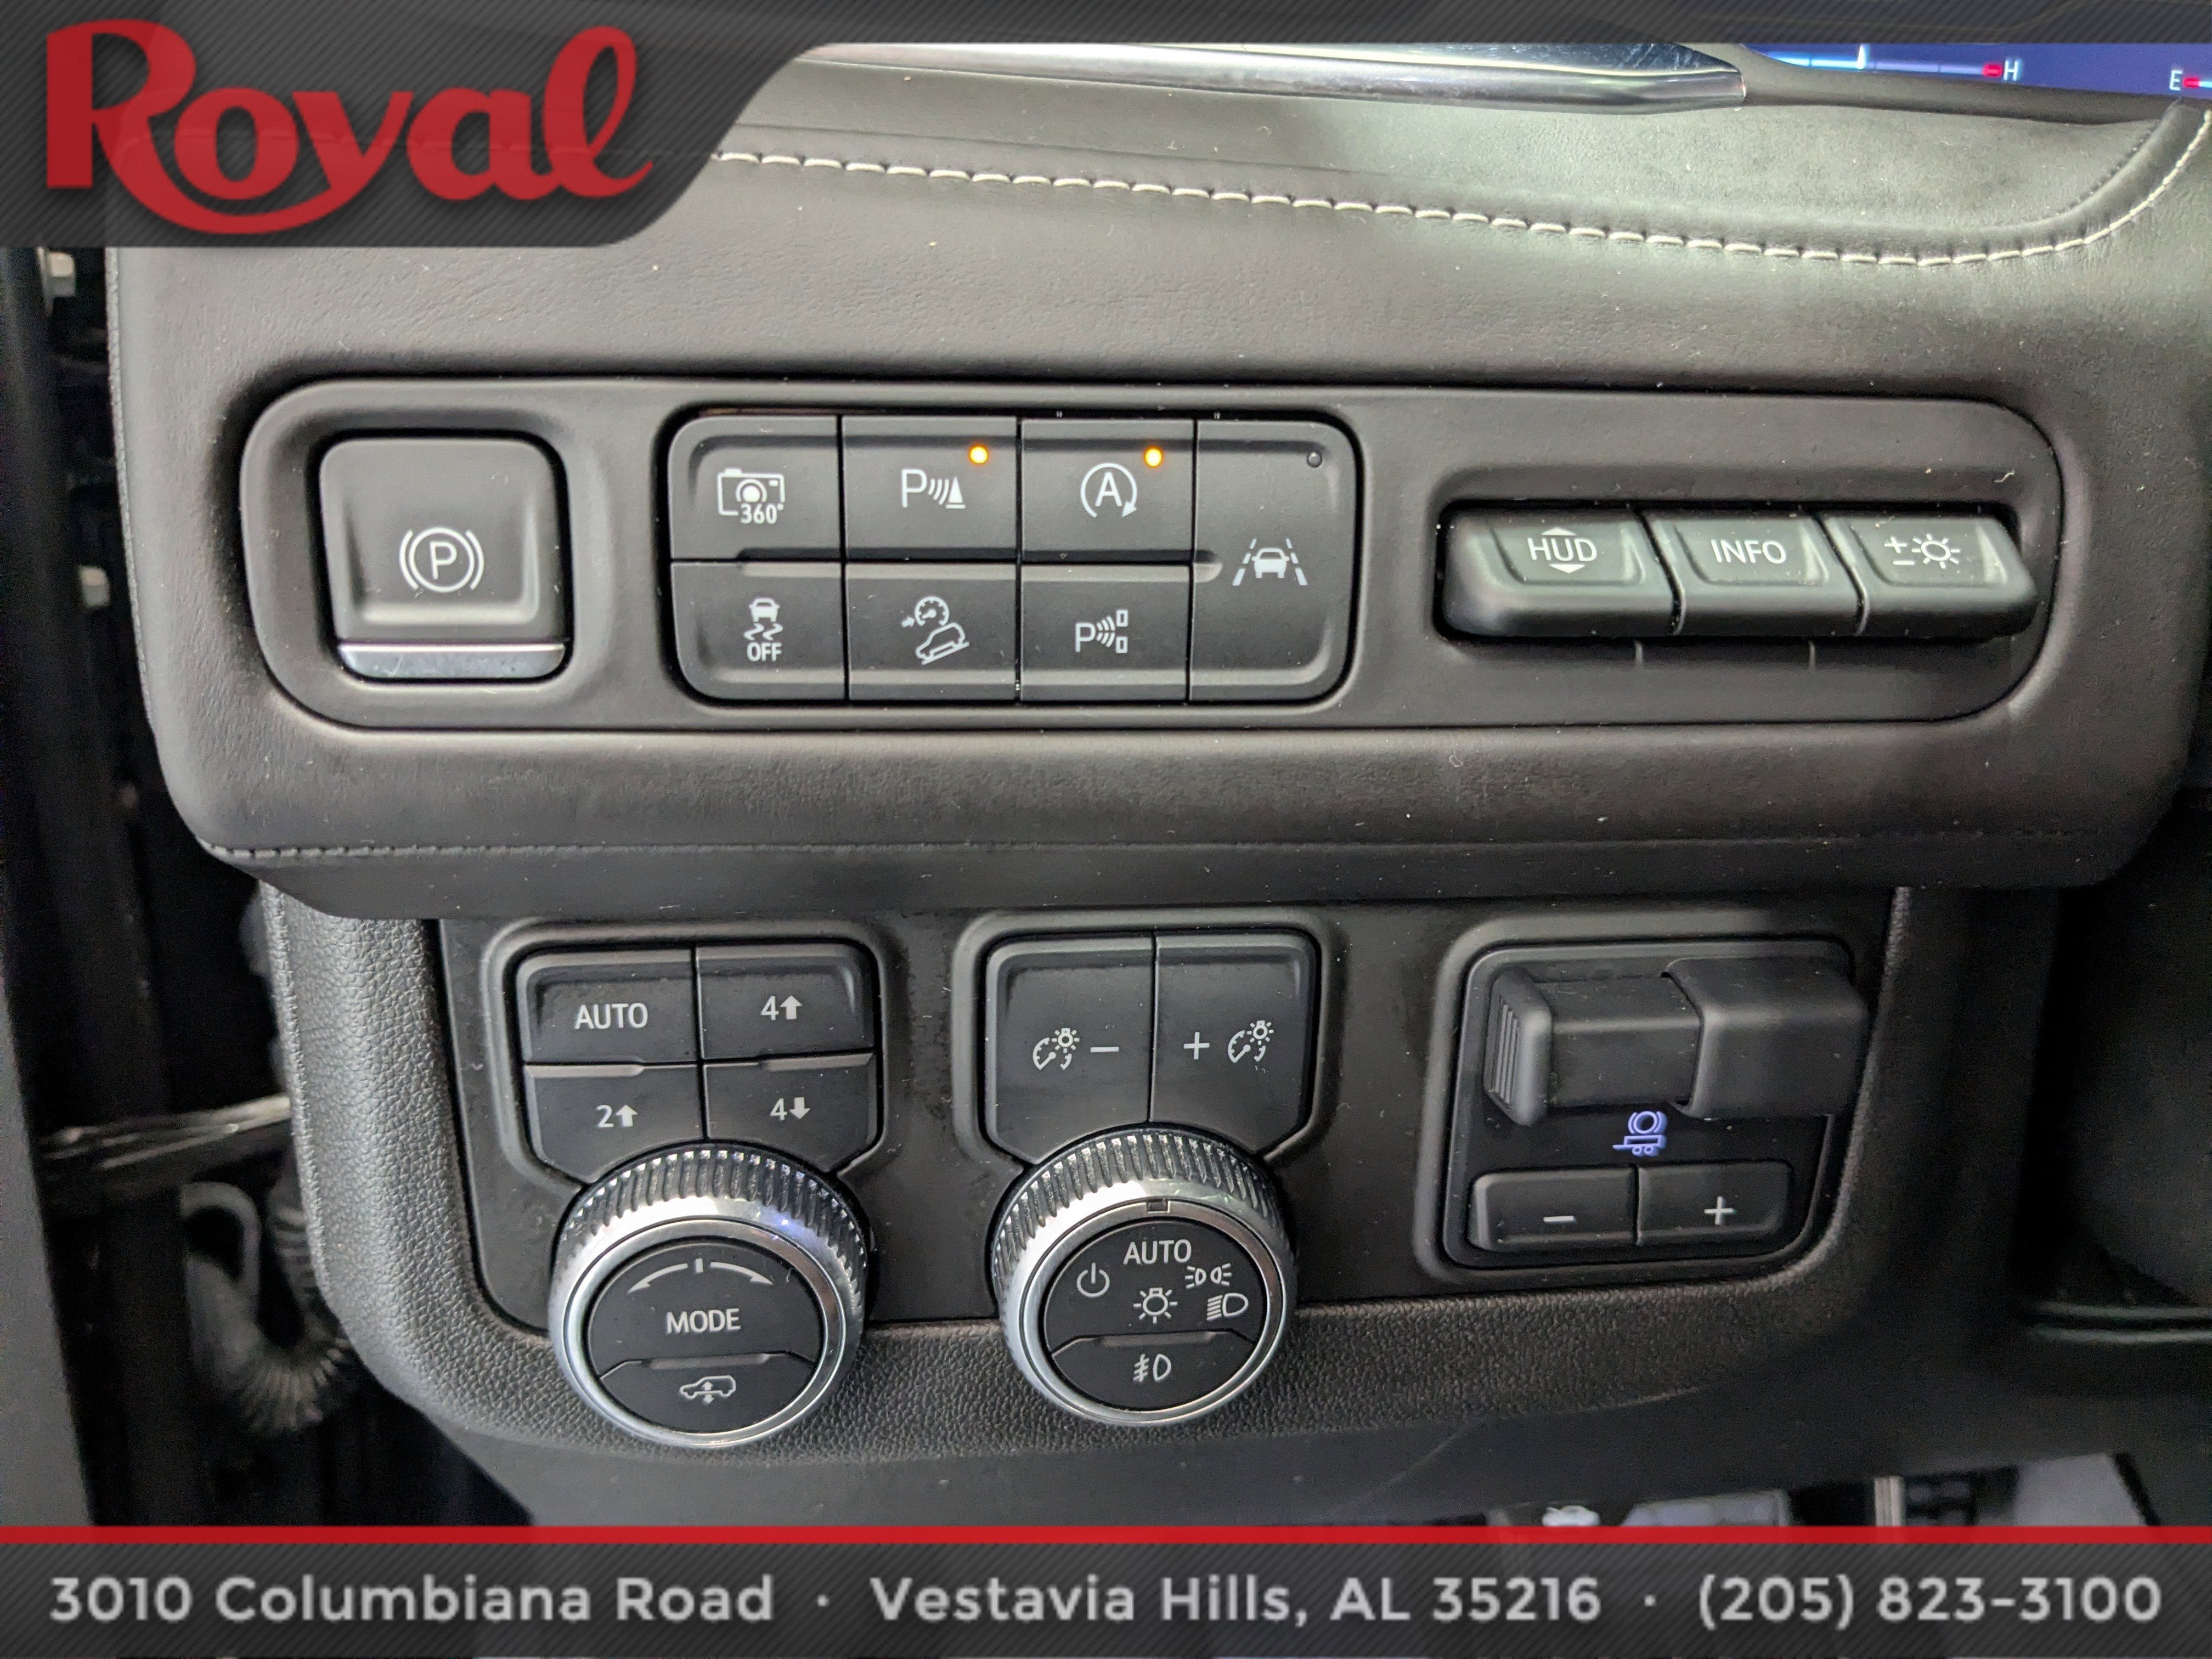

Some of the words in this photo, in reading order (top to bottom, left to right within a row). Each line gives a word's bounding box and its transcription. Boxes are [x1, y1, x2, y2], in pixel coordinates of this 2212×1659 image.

[2002, 60, 2019, 81] H
[2170, 70, 2182, 91] E
[1528, 536, 1597, 563] HUD
[1711, 539, 1786, 565] INFO
[747, 642, 782, 662] OFF
[575, 1002, 648, 1030] AUTO
[1124, 1239, 1192, 1265] AUTO
[666, 1308, 742, 1334] MODE
